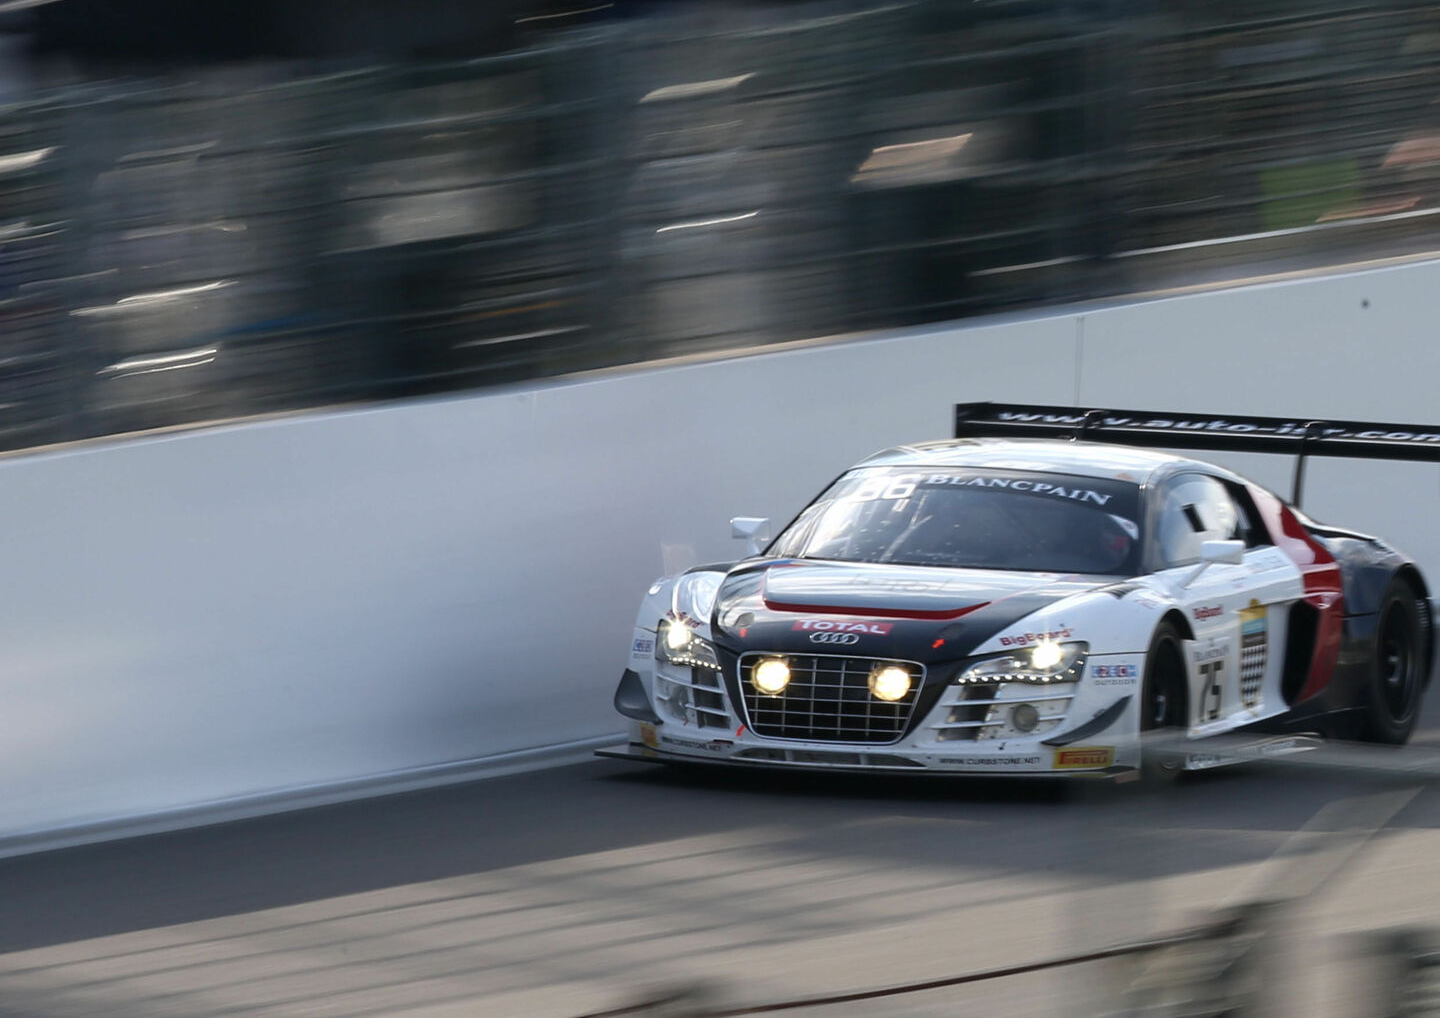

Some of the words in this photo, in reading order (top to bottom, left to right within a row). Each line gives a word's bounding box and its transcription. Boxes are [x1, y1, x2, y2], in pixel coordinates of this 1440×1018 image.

[925, 473, 1113, 506] BLANCPAIN
[799, 619, 888, 634] TOTAL
[1059, 750, 1110, 765] PIRELLI
